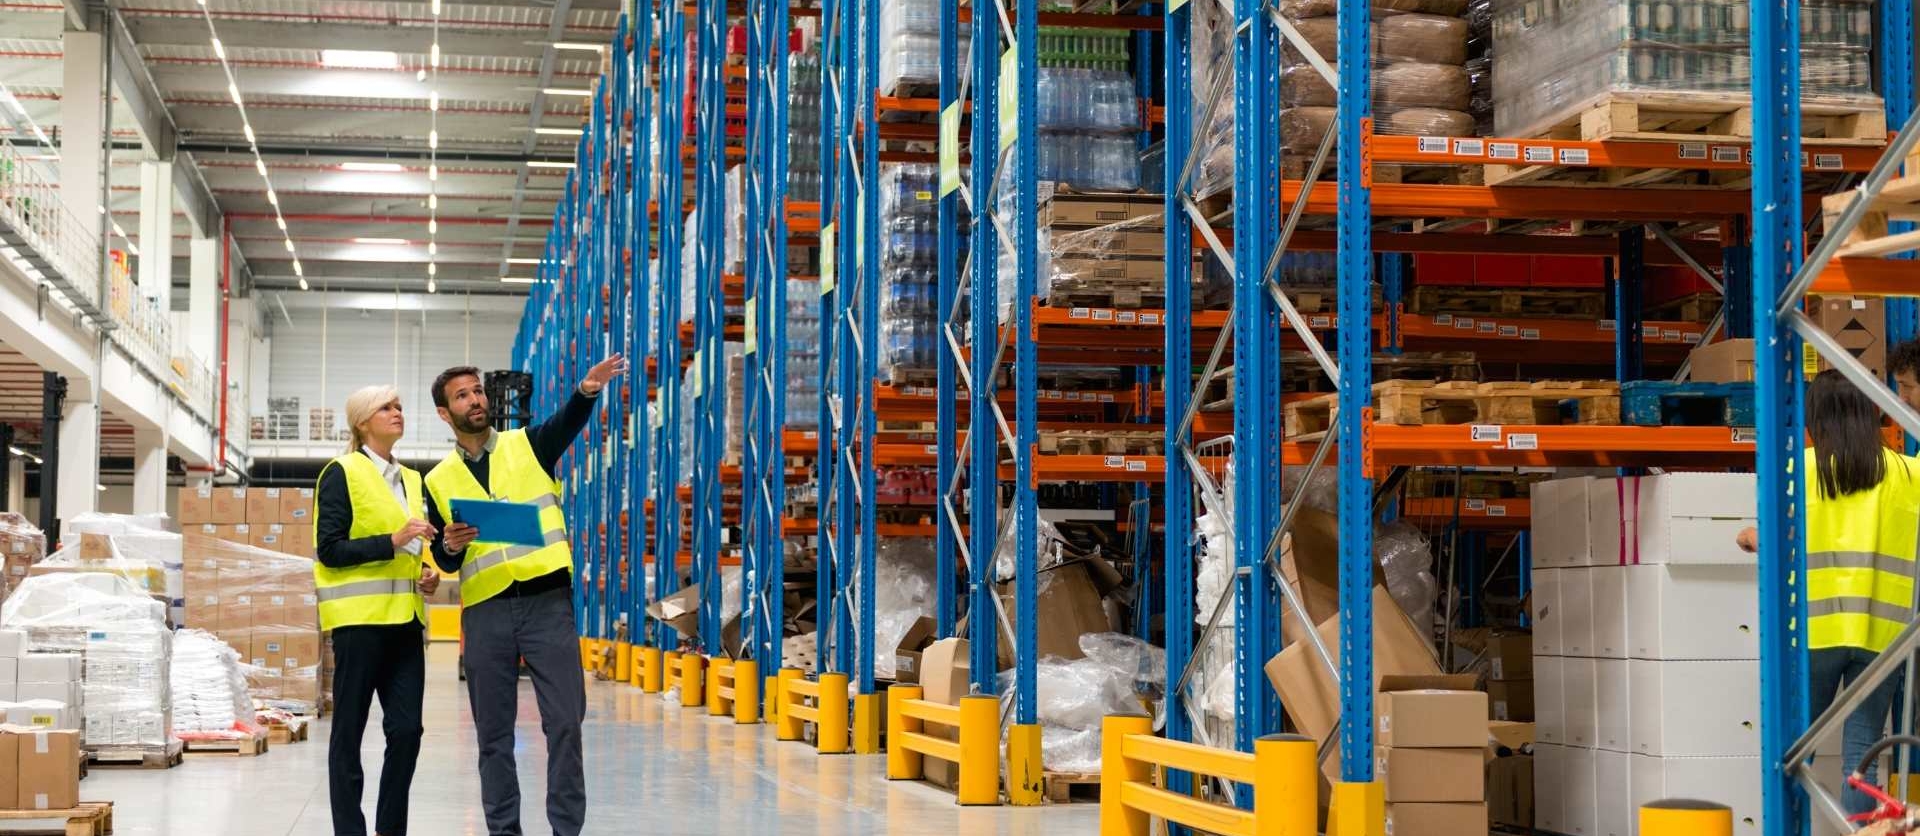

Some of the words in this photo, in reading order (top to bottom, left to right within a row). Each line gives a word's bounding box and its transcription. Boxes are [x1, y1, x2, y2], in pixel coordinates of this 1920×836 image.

[1419, 138, 1425, 151] 8
[1455, 141, 1460, 154] 7
[1489, 144, 1495, 157] 6
[1525, 147, 1531, 160] 5
[1560, 150, 1566, 162] 4
[1679, 144, 1685, 157] 8
[1713, 147, 1718, 160] 7
[1747, 150, 1752, 163] 6
[1815, 155, 1821, 168] 4
[1472, 426, 1478, 440] 2
[1509, 435, 1514, 448] 1
[1733, 428, 1738, 441] 2
